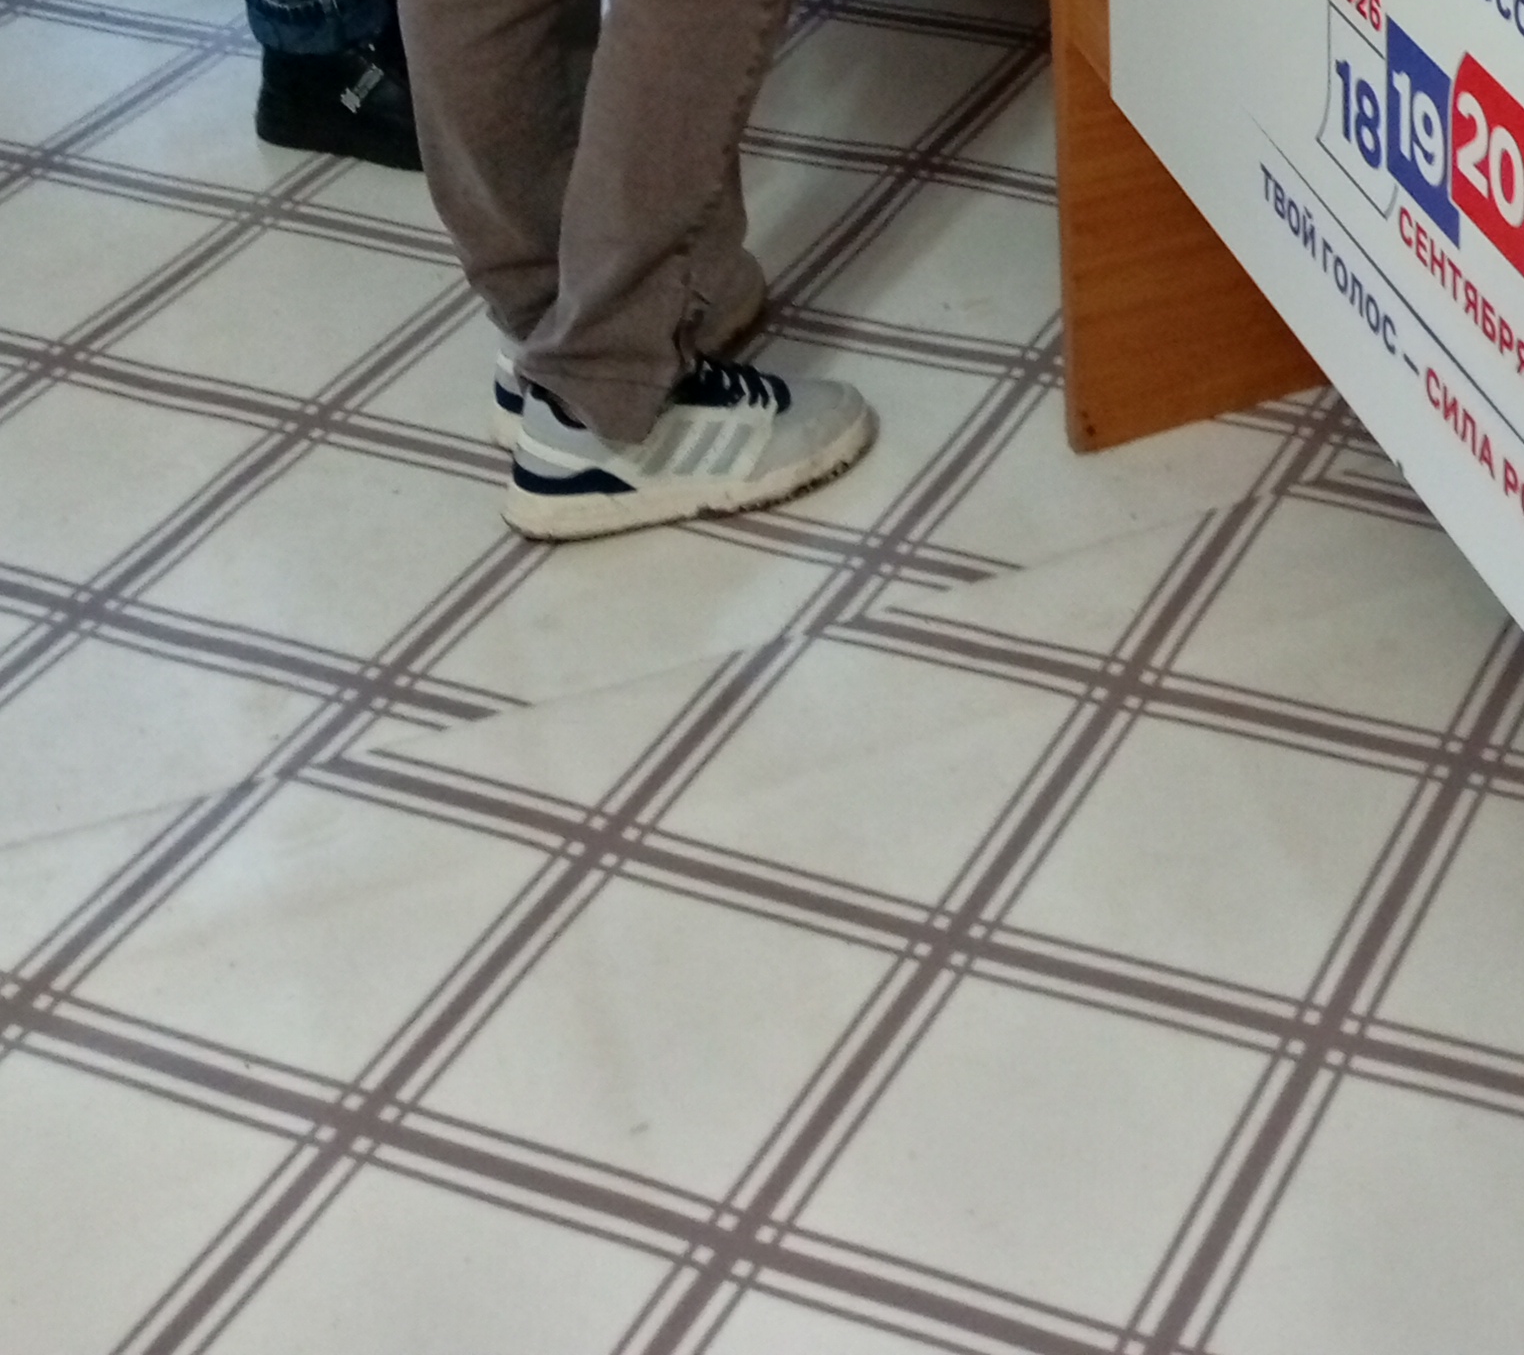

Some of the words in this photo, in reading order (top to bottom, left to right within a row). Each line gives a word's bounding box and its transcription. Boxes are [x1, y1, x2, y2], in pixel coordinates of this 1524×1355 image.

[1335, 59, 1382, 171] 18
[1391, 71, 1447, 188] 19
[1260, 162, 1317, 260] ТВОЙ
[1322, 238, 1397, 355] ГОЛОС
[1426, 367, 1496, 481] СИЛА
